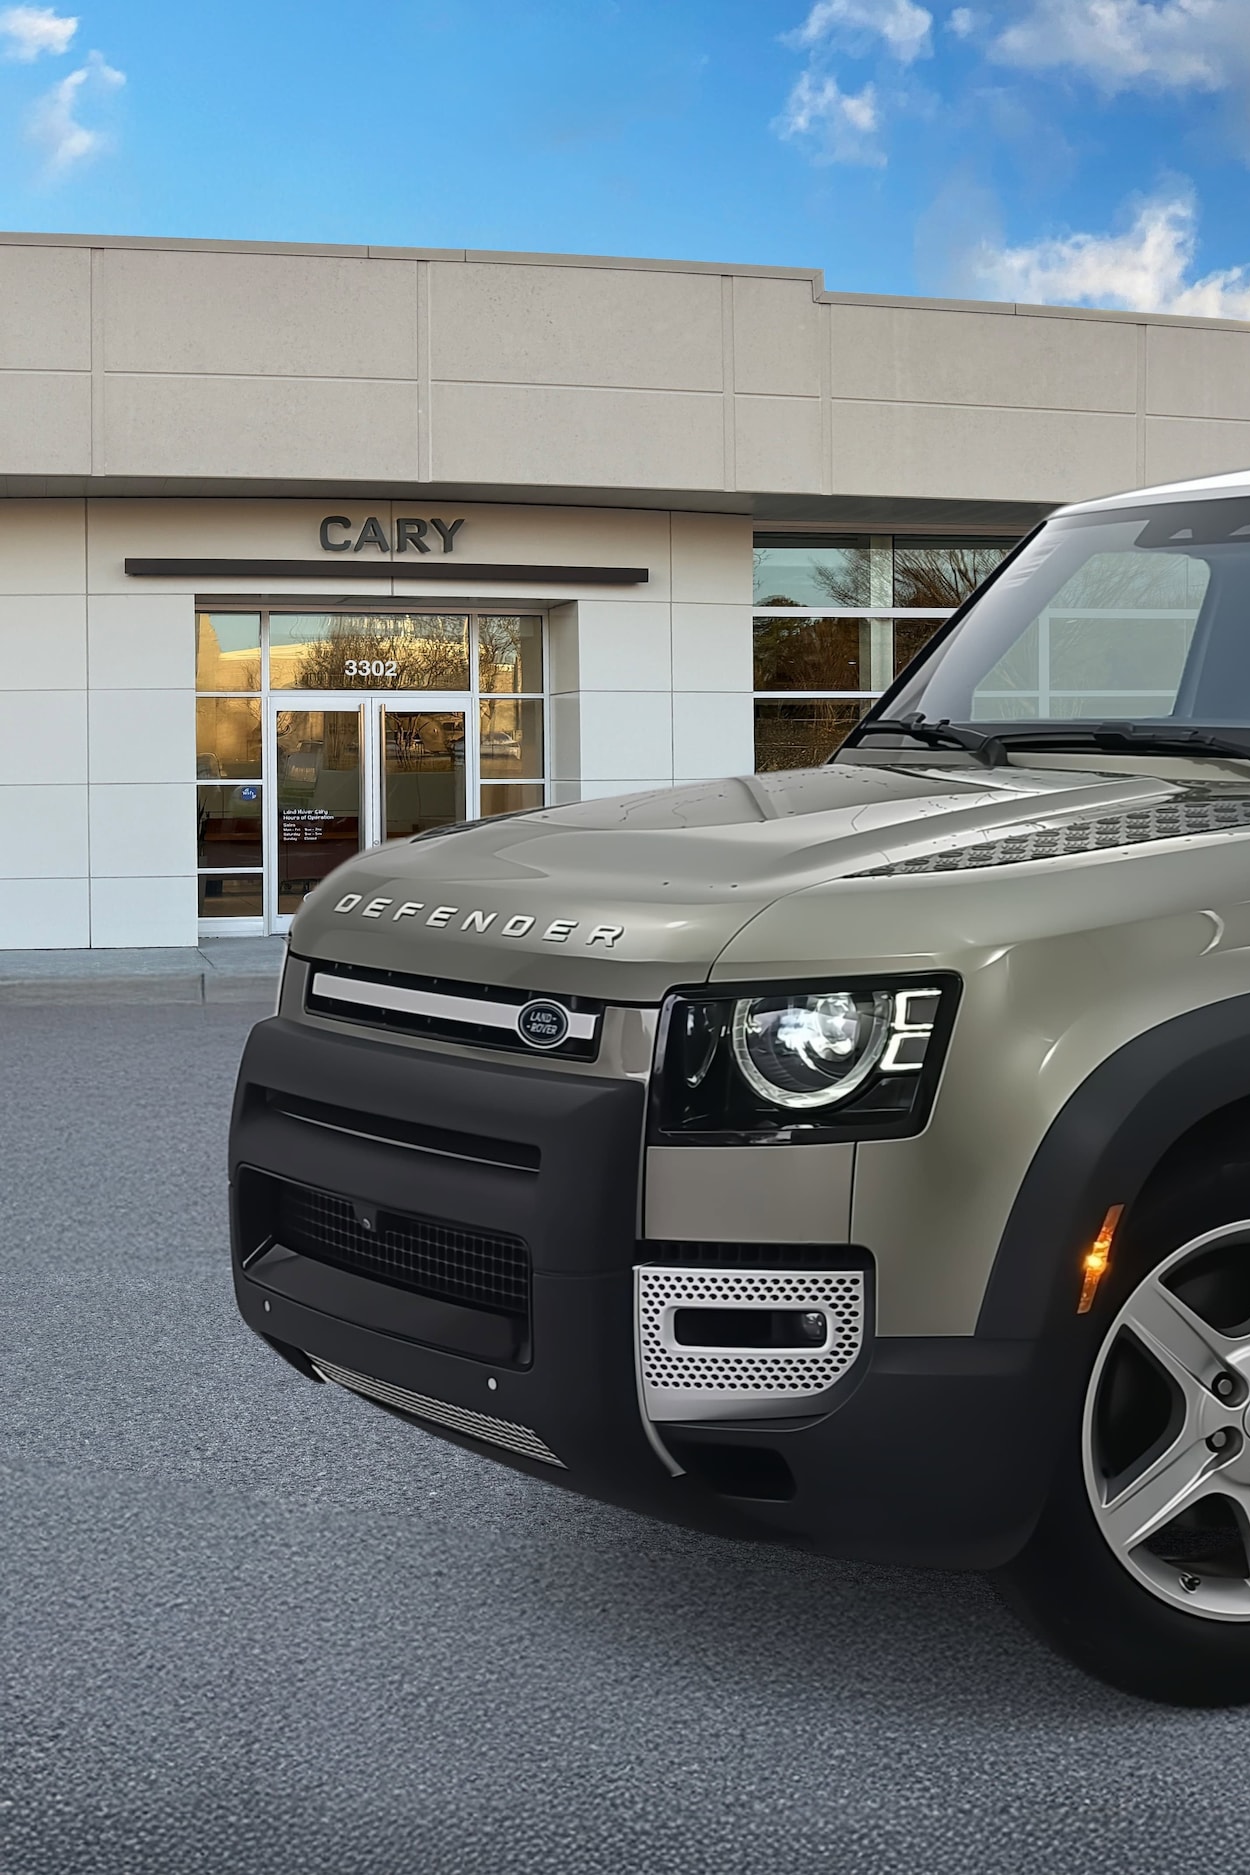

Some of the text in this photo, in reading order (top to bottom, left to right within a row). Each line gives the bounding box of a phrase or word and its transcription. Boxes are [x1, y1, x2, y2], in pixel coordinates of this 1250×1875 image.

[319, 515, 465, 553] CARY
[345, 660, 397, 676] 3302
[334, 893, 624, 947] DEFENDER
[530, 1011, 552, 1023] LAND
[530, 1022, 558, 1035] ROVER
